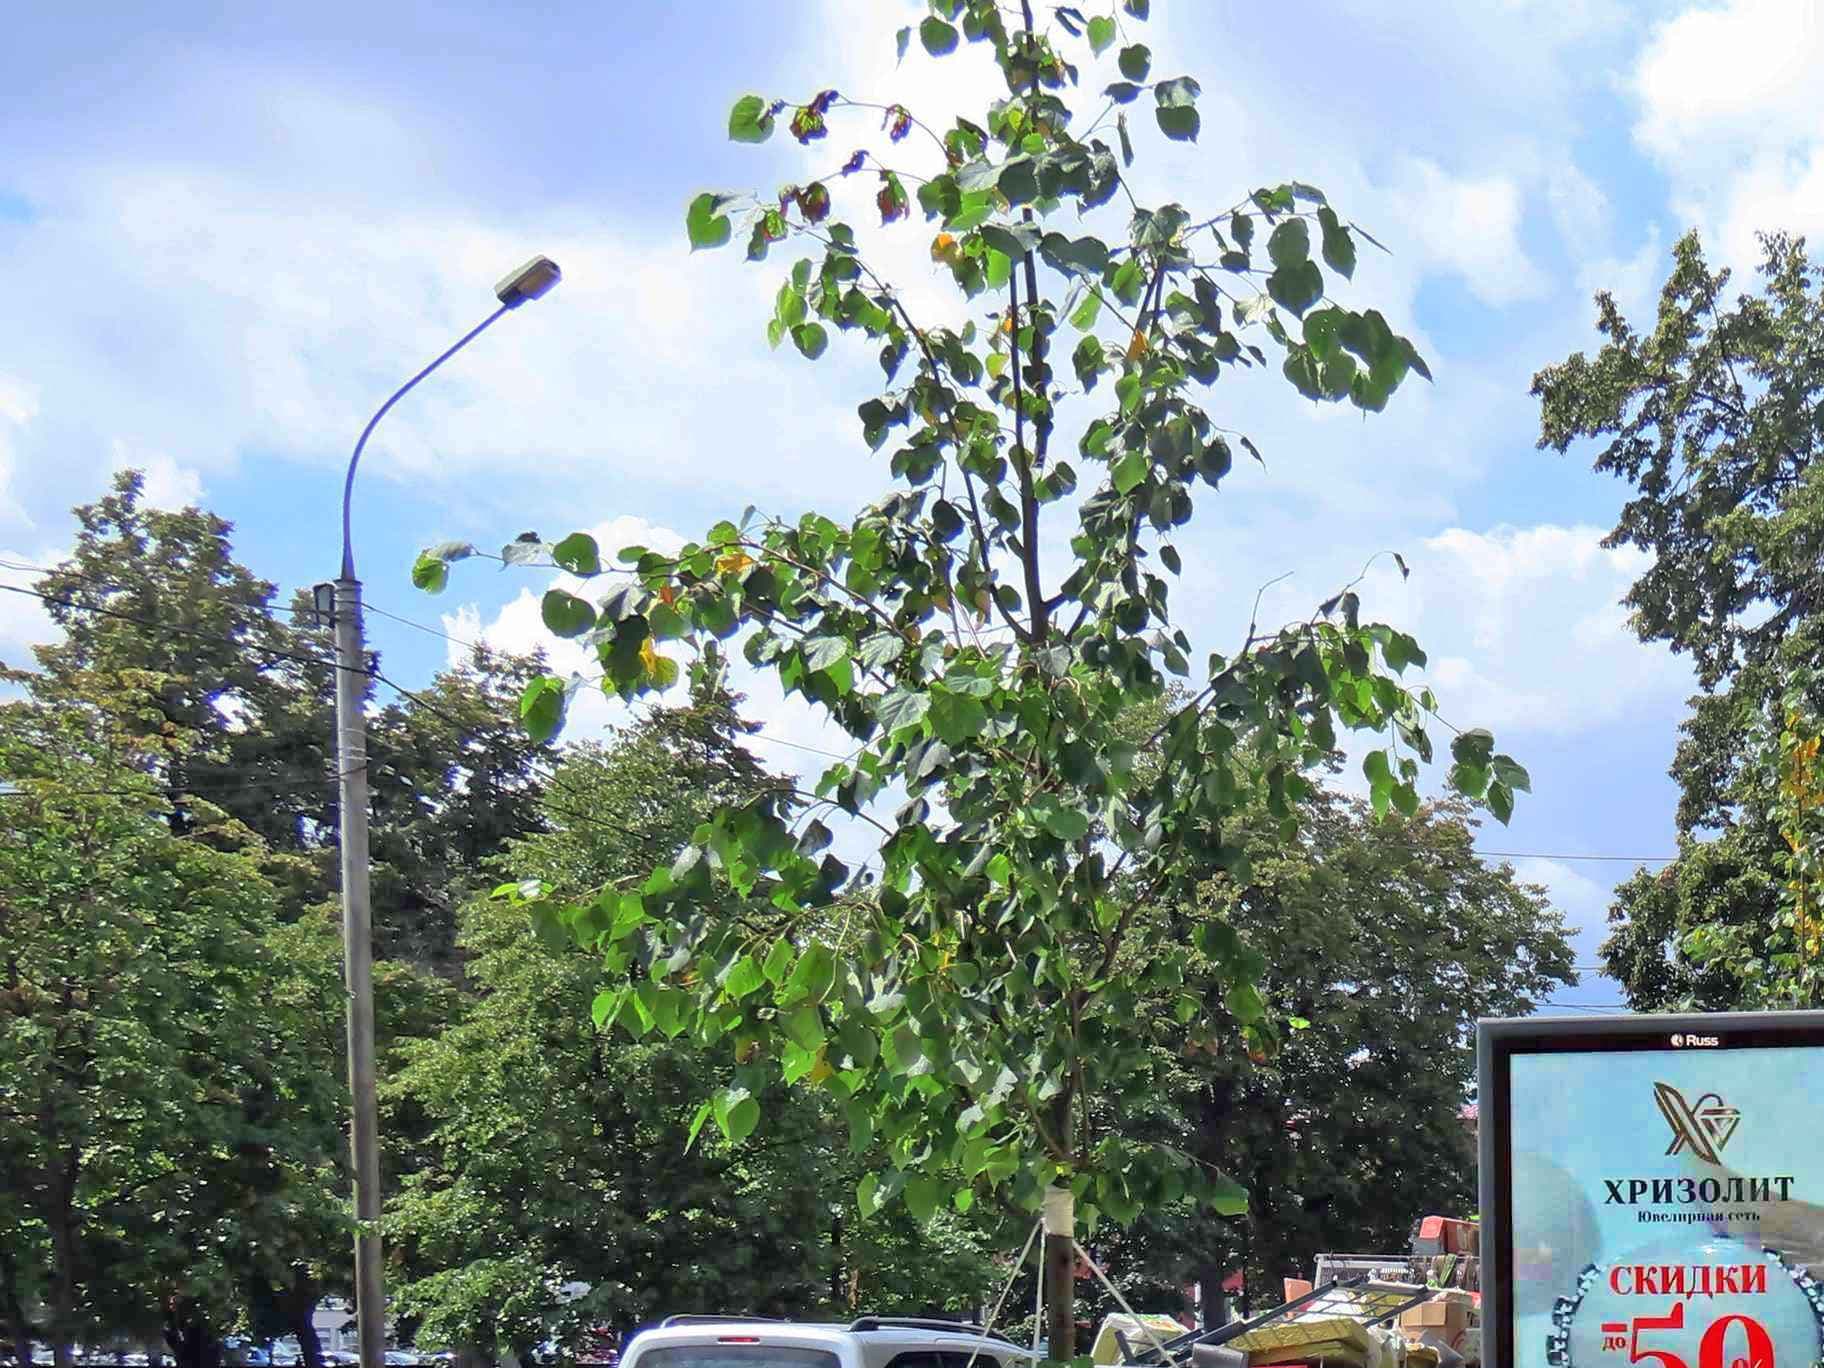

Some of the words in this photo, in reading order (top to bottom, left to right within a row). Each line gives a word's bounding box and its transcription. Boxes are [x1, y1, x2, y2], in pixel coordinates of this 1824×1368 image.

[1686, 1034, 1719, 1046] Russ
[1603, 1177, 1794, 1204] ХРИЗОЛИТ
[1638, 1211, 1723, 1224] Ювелирная
[1728, 1212, 1760, 1222] сеть
[1610, 1265, 1767, 1299] СКИДКИ
[1602, 1336, 1626, 1351] до
